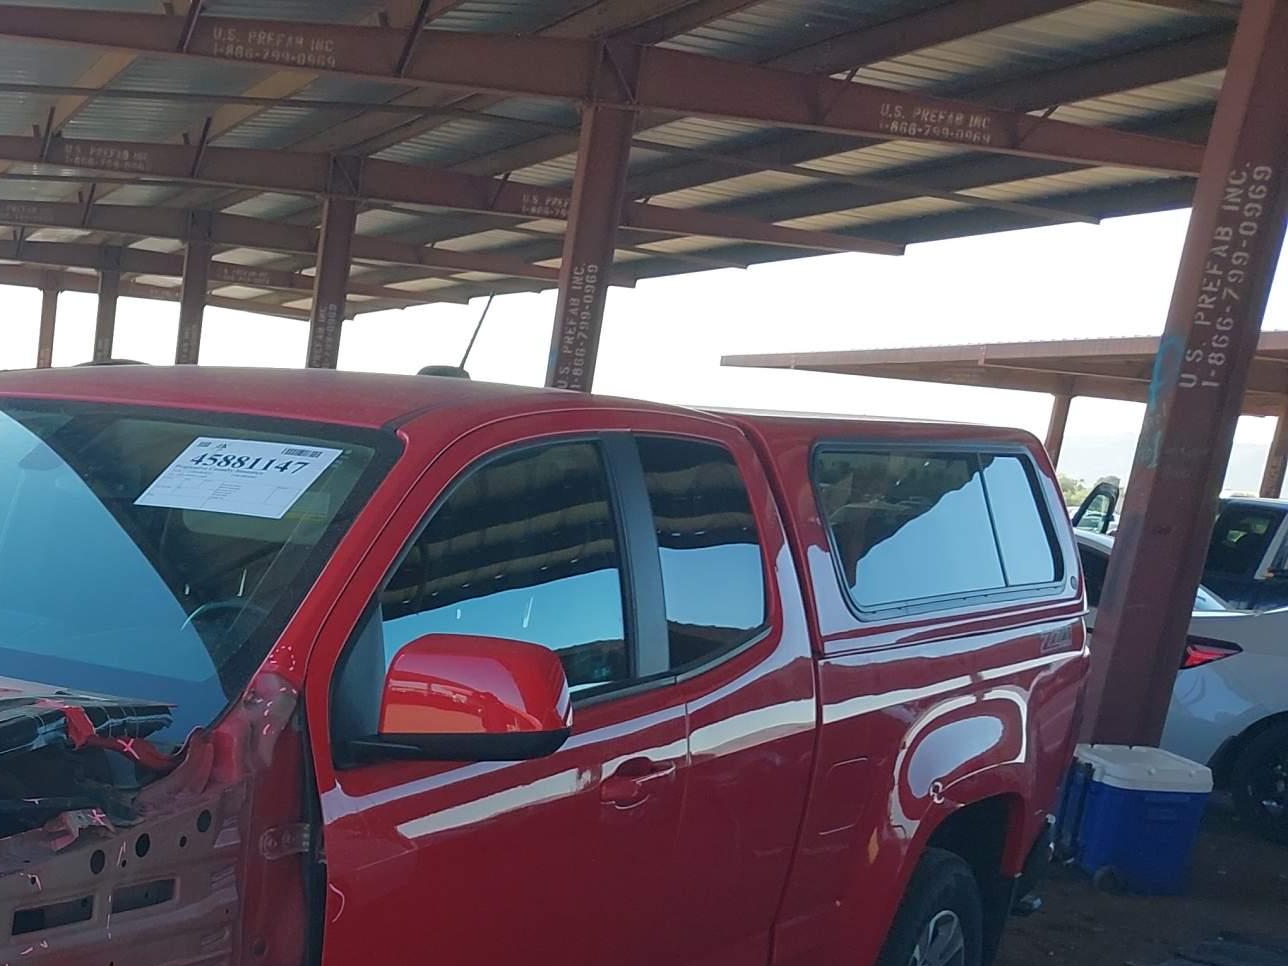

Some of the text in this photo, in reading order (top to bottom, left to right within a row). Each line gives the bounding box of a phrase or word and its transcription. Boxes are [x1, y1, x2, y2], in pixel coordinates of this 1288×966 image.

[880, 103, 905, 119] U.S.
[913, 108, 964, 126] PREFAB
[1194, 226, 1234, 326] PREFAB
[1201, 165, 1272, 388] 1-866-799-0969
[563, 297, 581, 354] PREFAB
[190, 452, 310, 474] 45881147
